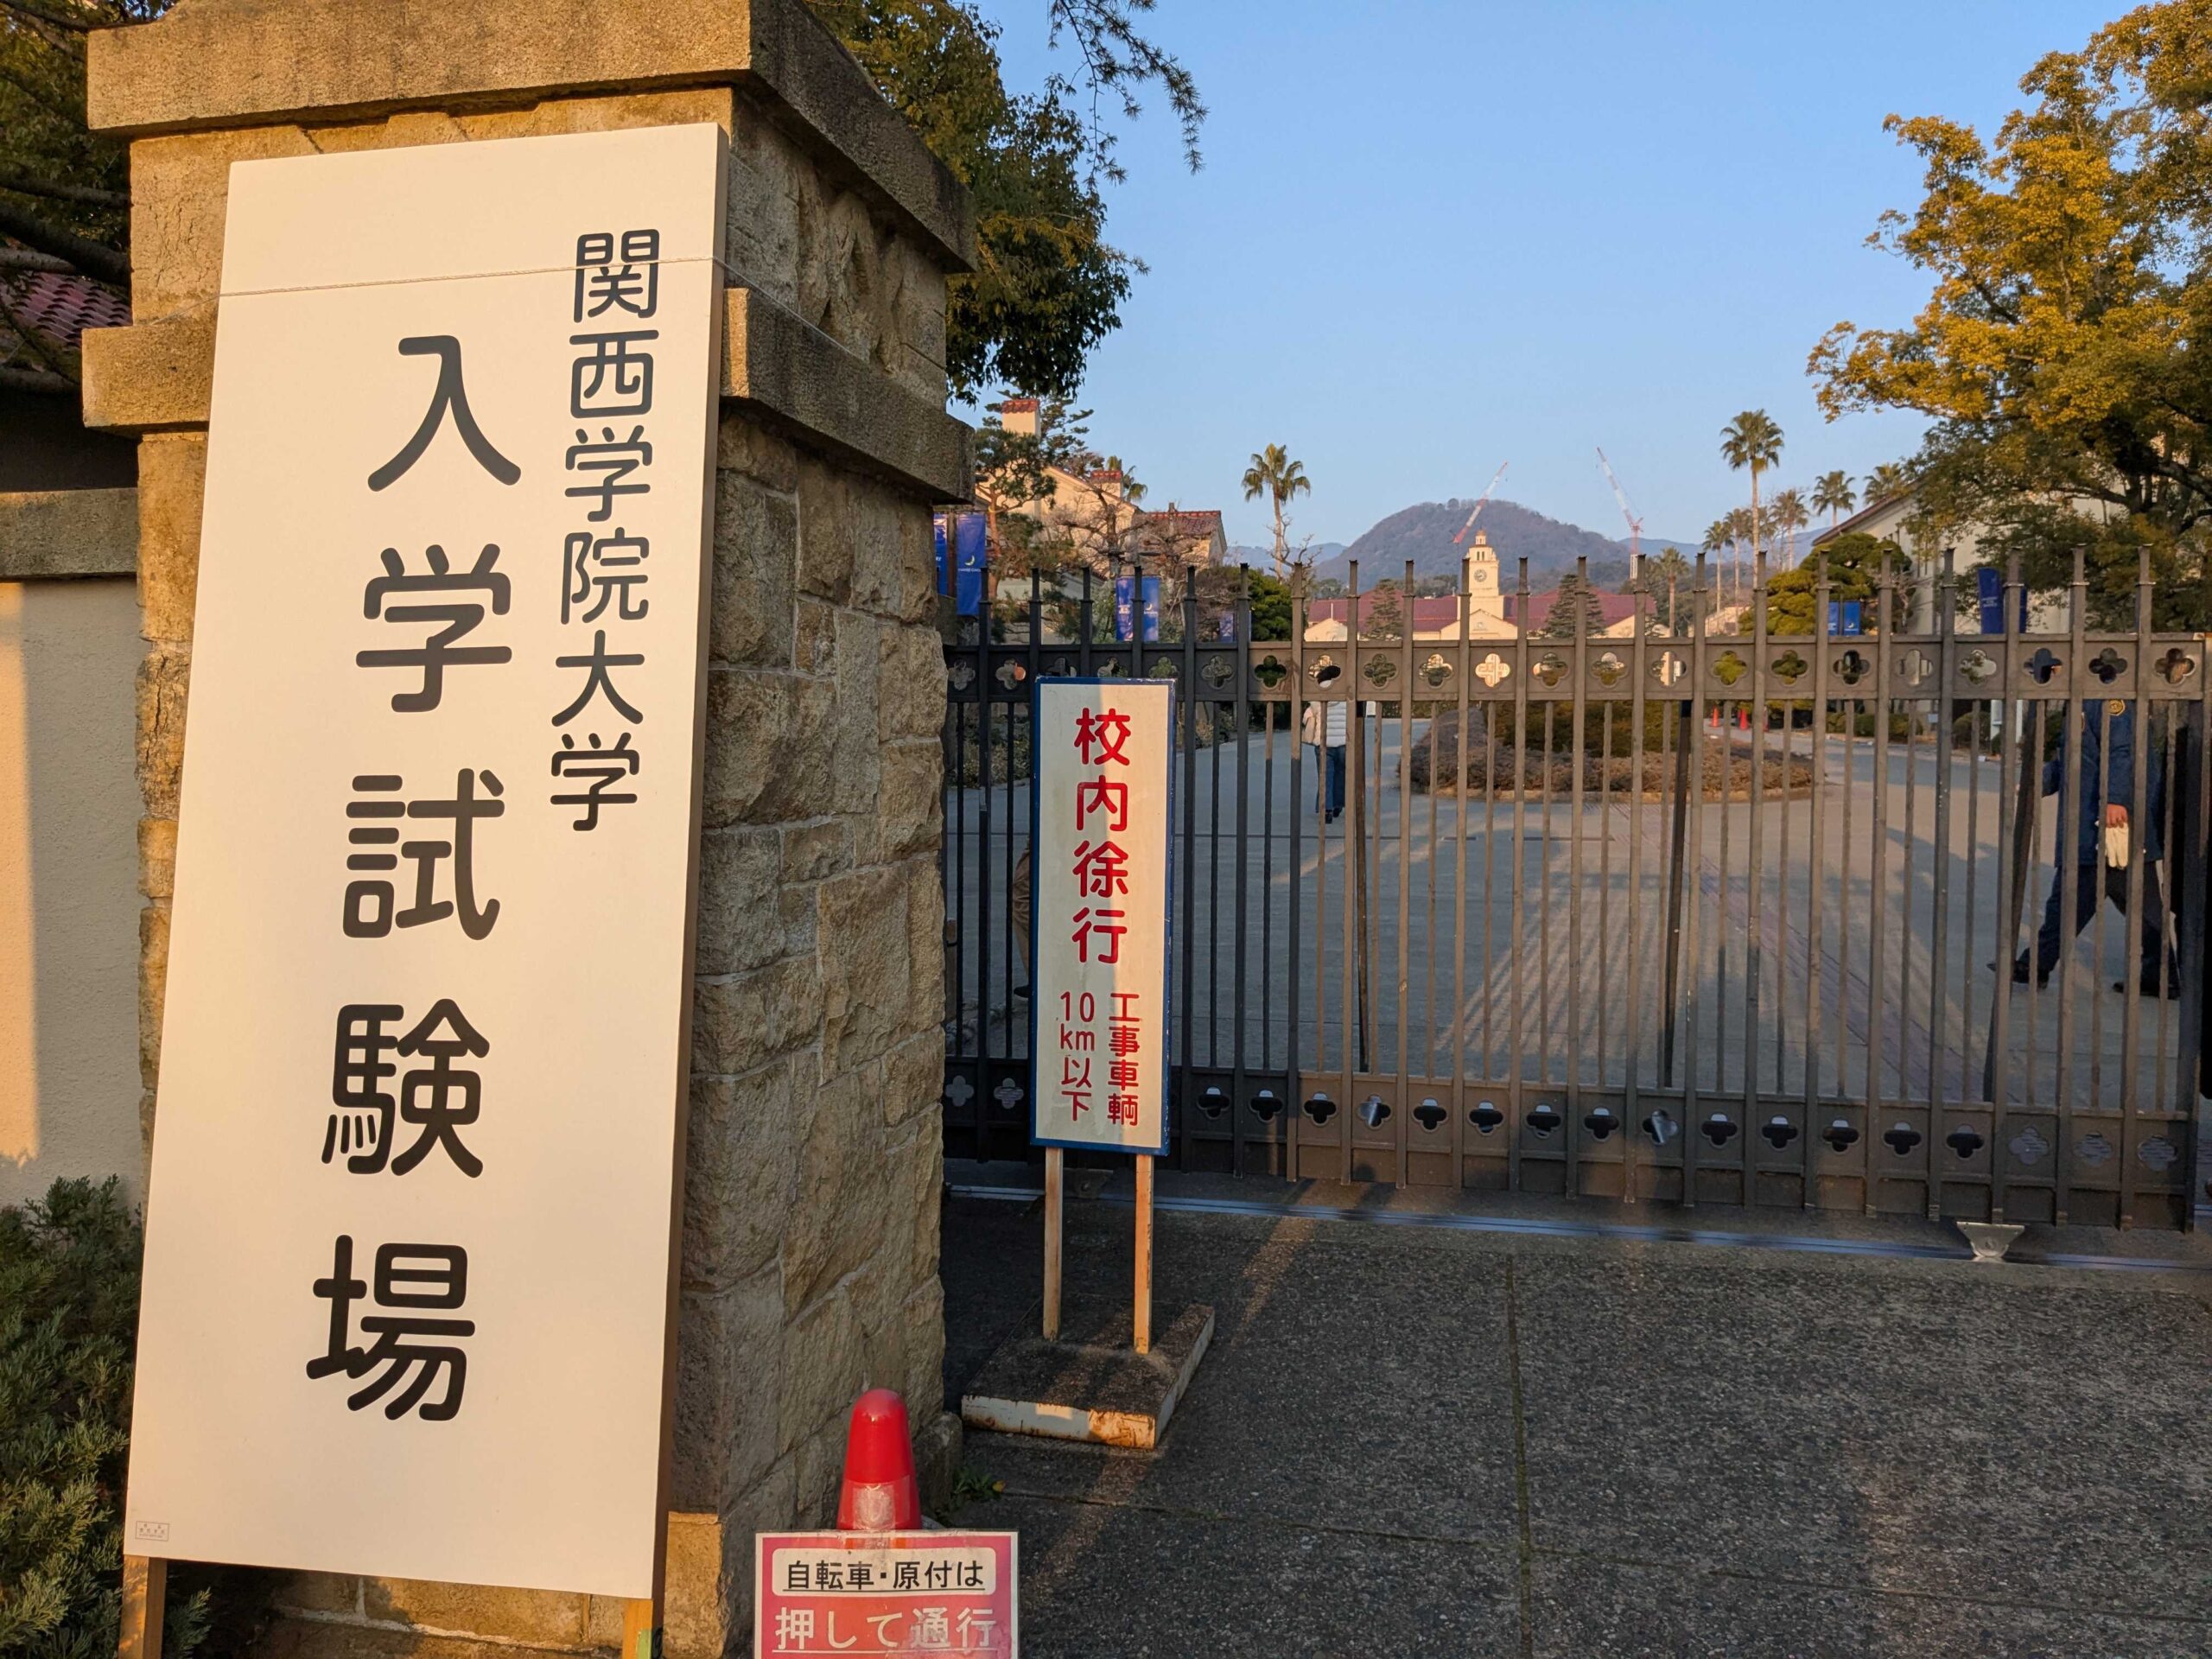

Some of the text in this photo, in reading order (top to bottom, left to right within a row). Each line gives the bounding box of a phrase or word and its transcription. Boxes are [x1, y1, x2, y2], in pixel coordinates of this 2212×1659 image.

[550, 228, 660, 831] 関西学院大学
[306, 334, 521, 1421] 入学試験場
[1072, 707, 1132, 965] 校内徐行
[775, 1606, 995, 1650] 押して通行
[787, 1560, 984, 1590] 自転車・原付は
